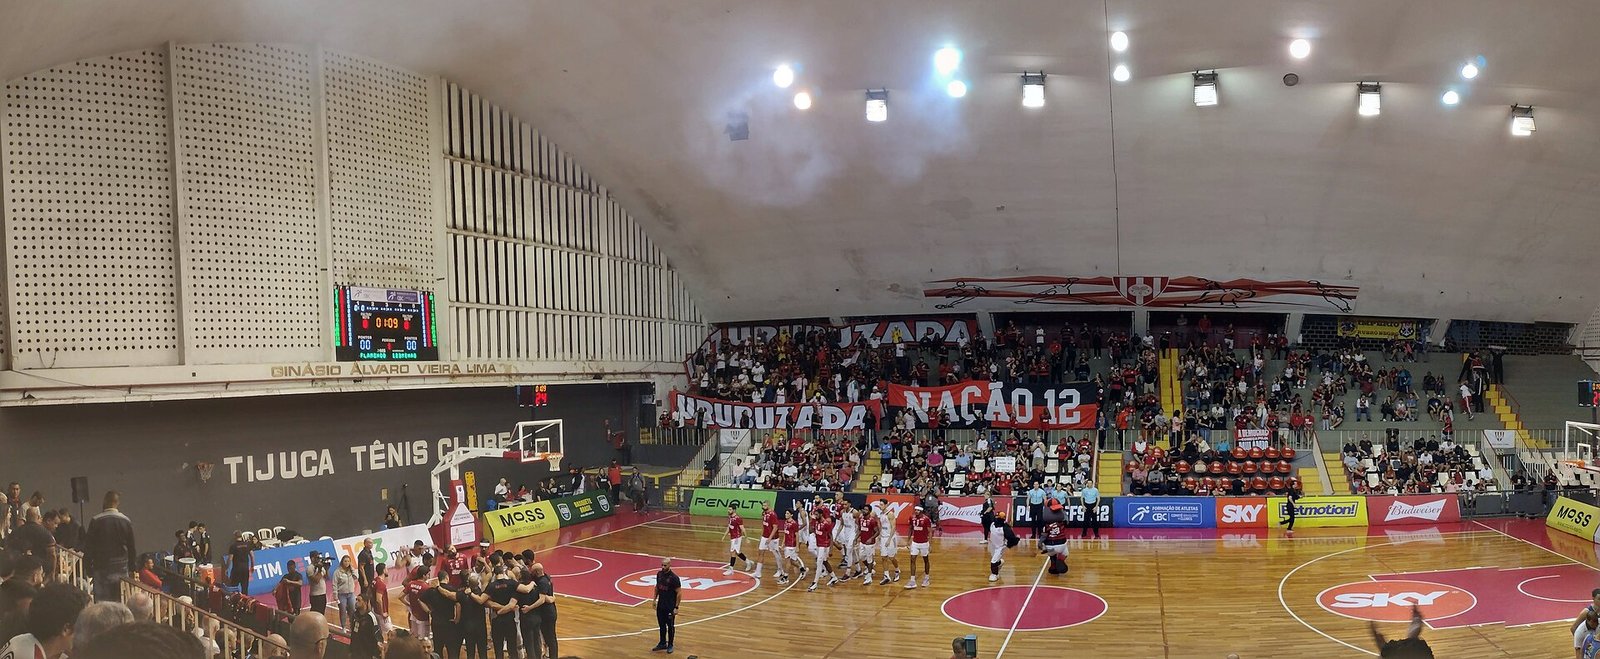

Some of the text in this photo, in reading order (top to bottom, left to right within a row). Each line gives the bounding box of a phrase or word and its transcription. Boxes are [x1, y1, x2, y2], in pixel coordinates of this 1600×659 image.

[271, 359, 497, 377] GINÁSIO ÁLVARO VIEIRA LIMA
[904, 381, 1080, 425] NAÇÃO 12
[223, 448, 335, 484] TIJUCA
[350, 439, 428, 472] TÊNIS
[694, 498, 768, 510] PENALTY
[1282, 504, 1354, 515] Betmotion!
[1390, 504, 1442, 516] Budweiser
[1152, 513, 1167, 521] CBC
[1222, 504, 1263, 522] SKY
[254, 561, 282, 580] TIM
[1330, 591, 1449, 608] SKY
